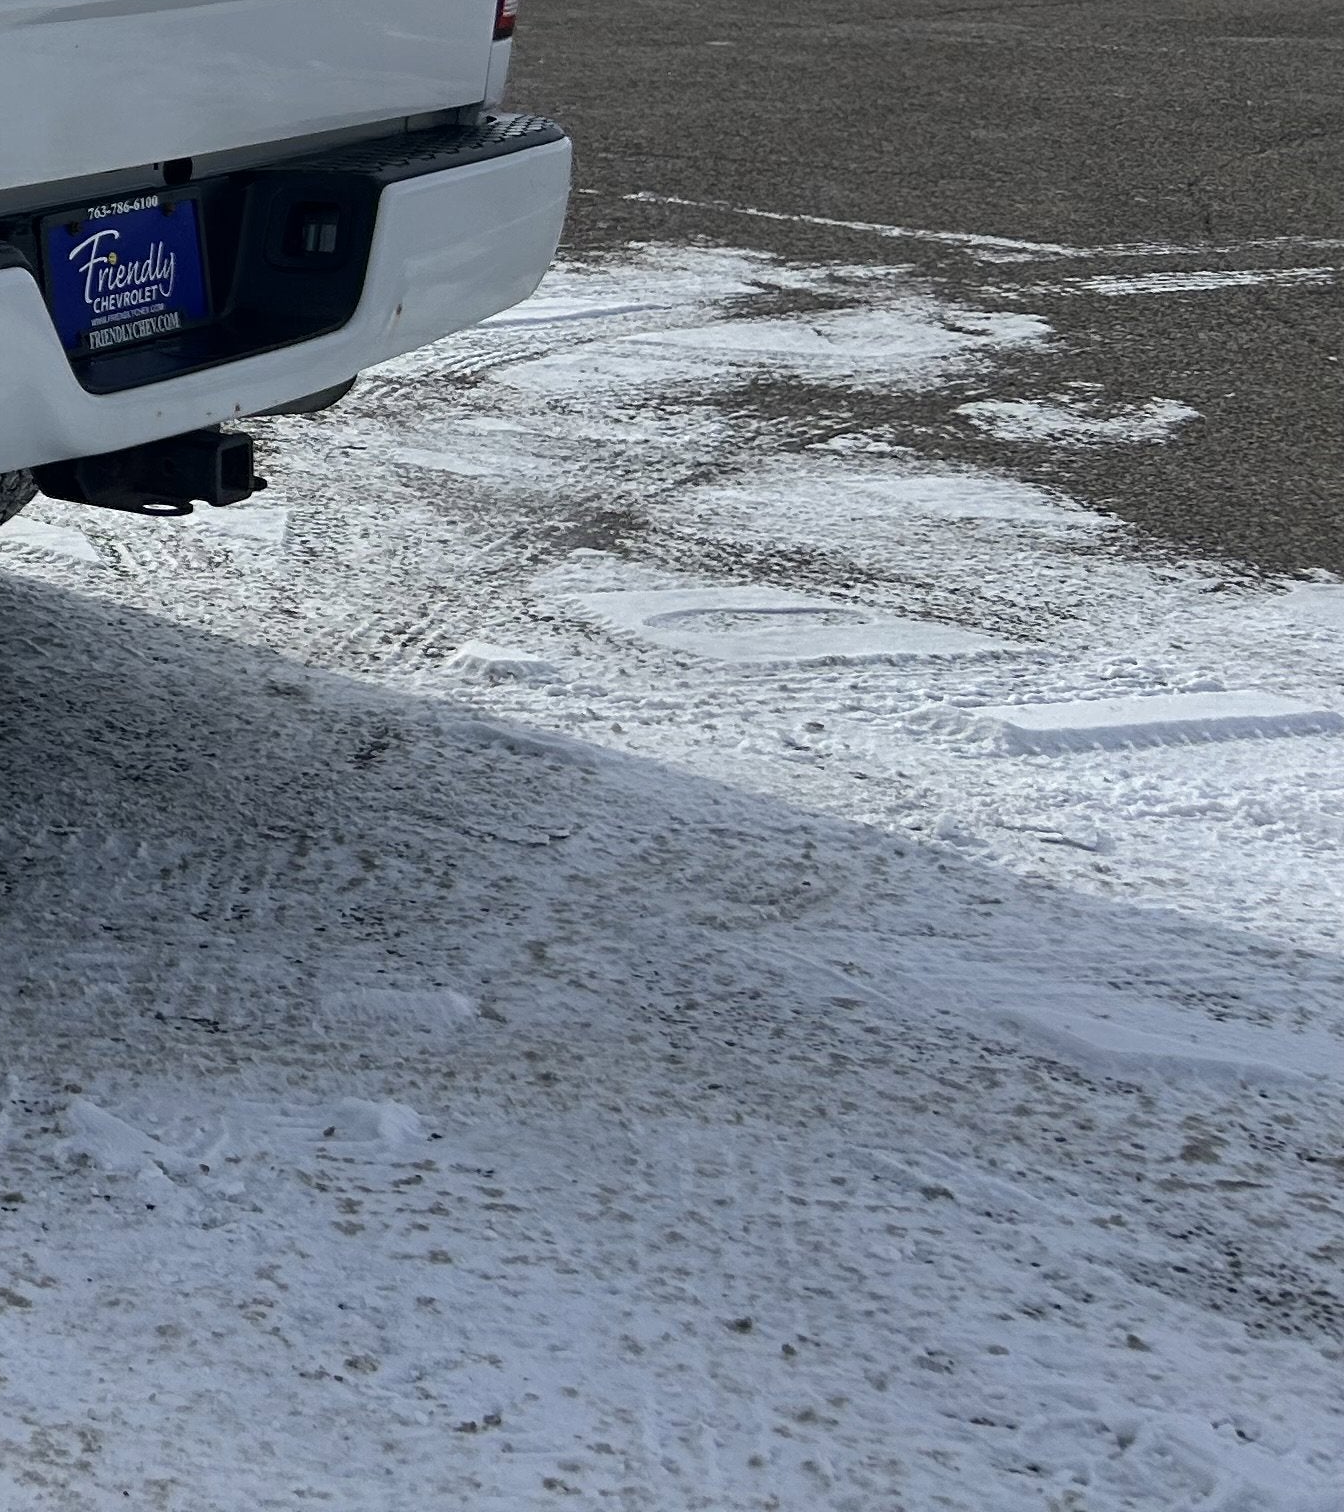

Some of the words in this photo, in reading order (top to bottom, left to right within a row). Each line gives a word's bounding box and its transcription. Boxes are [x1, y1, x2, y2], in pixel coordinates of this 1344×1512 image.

[87, 195, 159, 220] 763-786-6100
[68, 229, 176, 304] Friendly
[93, 285, 159, 314] CHEVROLET
[89, 311, 182, 350] FRIENDLYCHEV.COM
